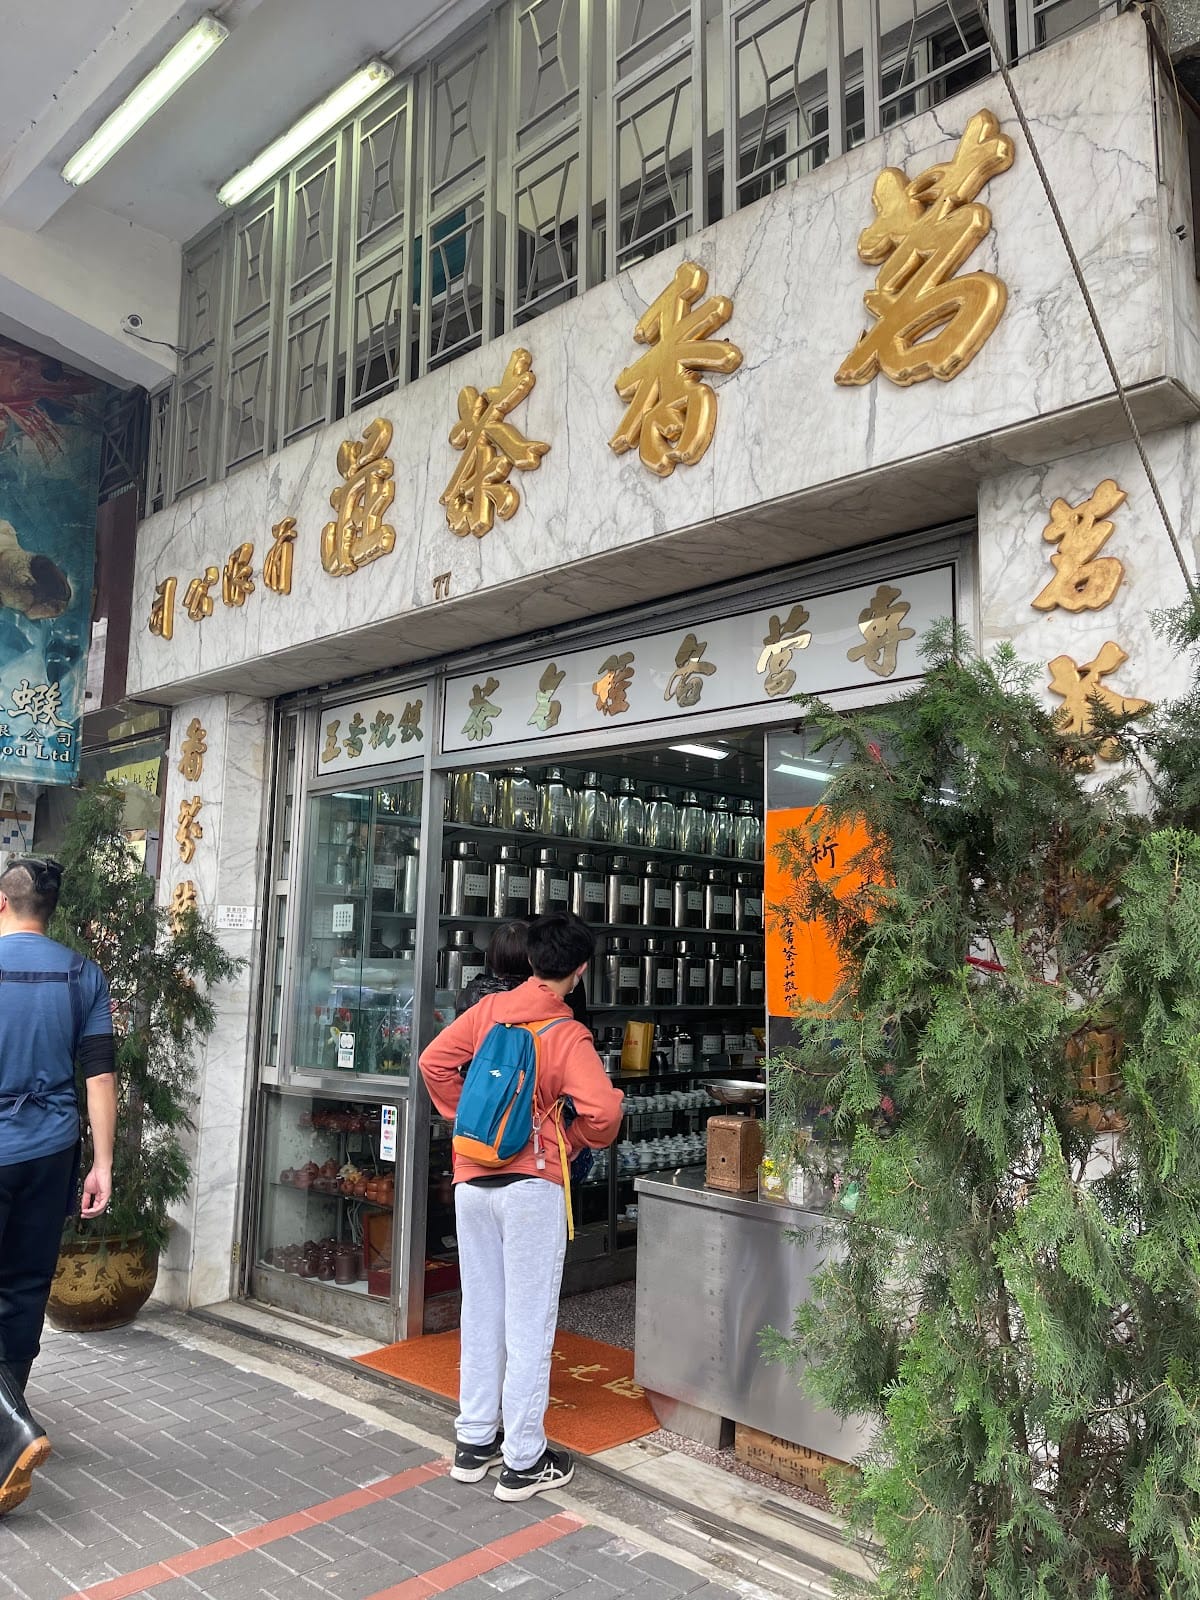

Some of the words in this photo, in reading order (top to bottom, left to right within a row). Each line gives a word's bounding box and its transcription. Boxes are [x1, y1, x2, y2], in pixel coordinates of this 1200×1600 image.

[432, 571, 452, 600] 77
[0, 679, 74, 730] 蝦
[36, 743, 75, 762] Ltd.
